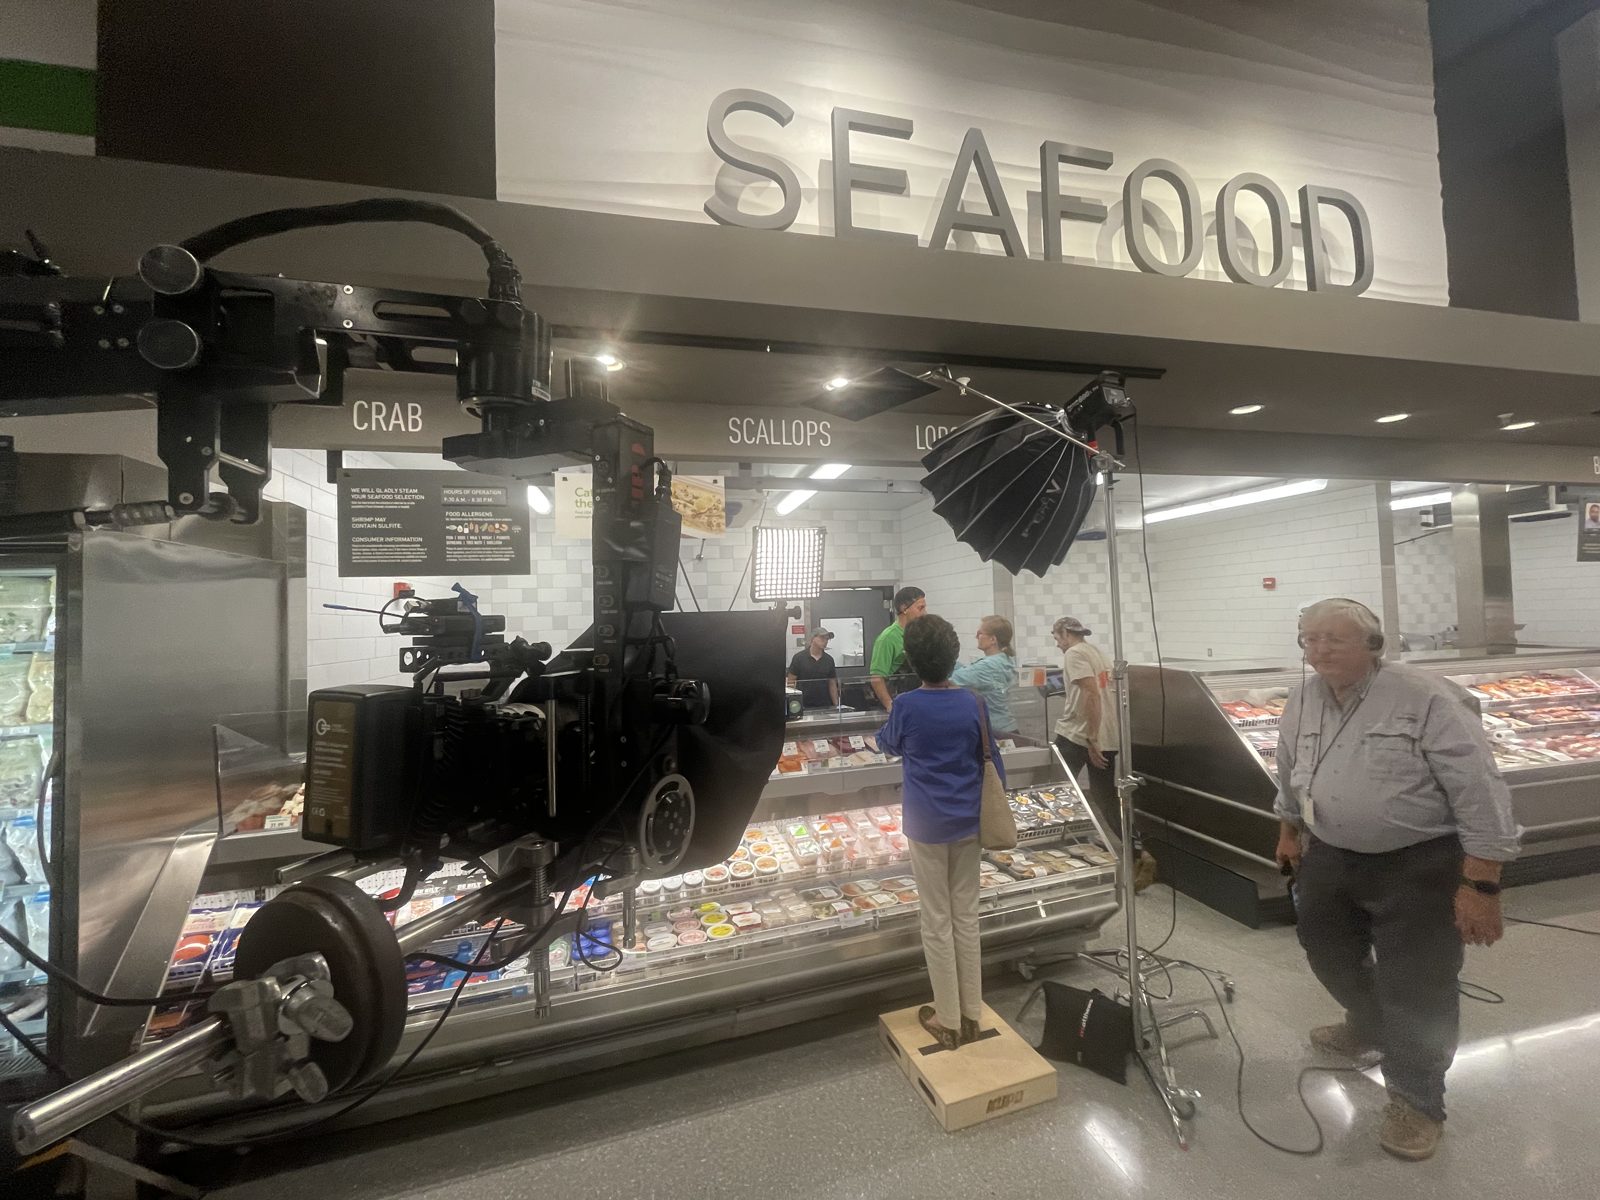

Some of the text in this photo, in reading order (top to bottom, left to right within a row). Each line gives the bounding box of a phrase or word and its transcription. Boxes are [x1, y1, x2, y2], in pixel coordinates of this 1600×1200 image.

[703, 88, 1374, 297] SEAFOOD
[353, 400, 423, 432] CRAB
[728, 417, 832, 447] SCALLOPS
[915, 424, 958, 450] LO
[575, 498, 593, 508] the
